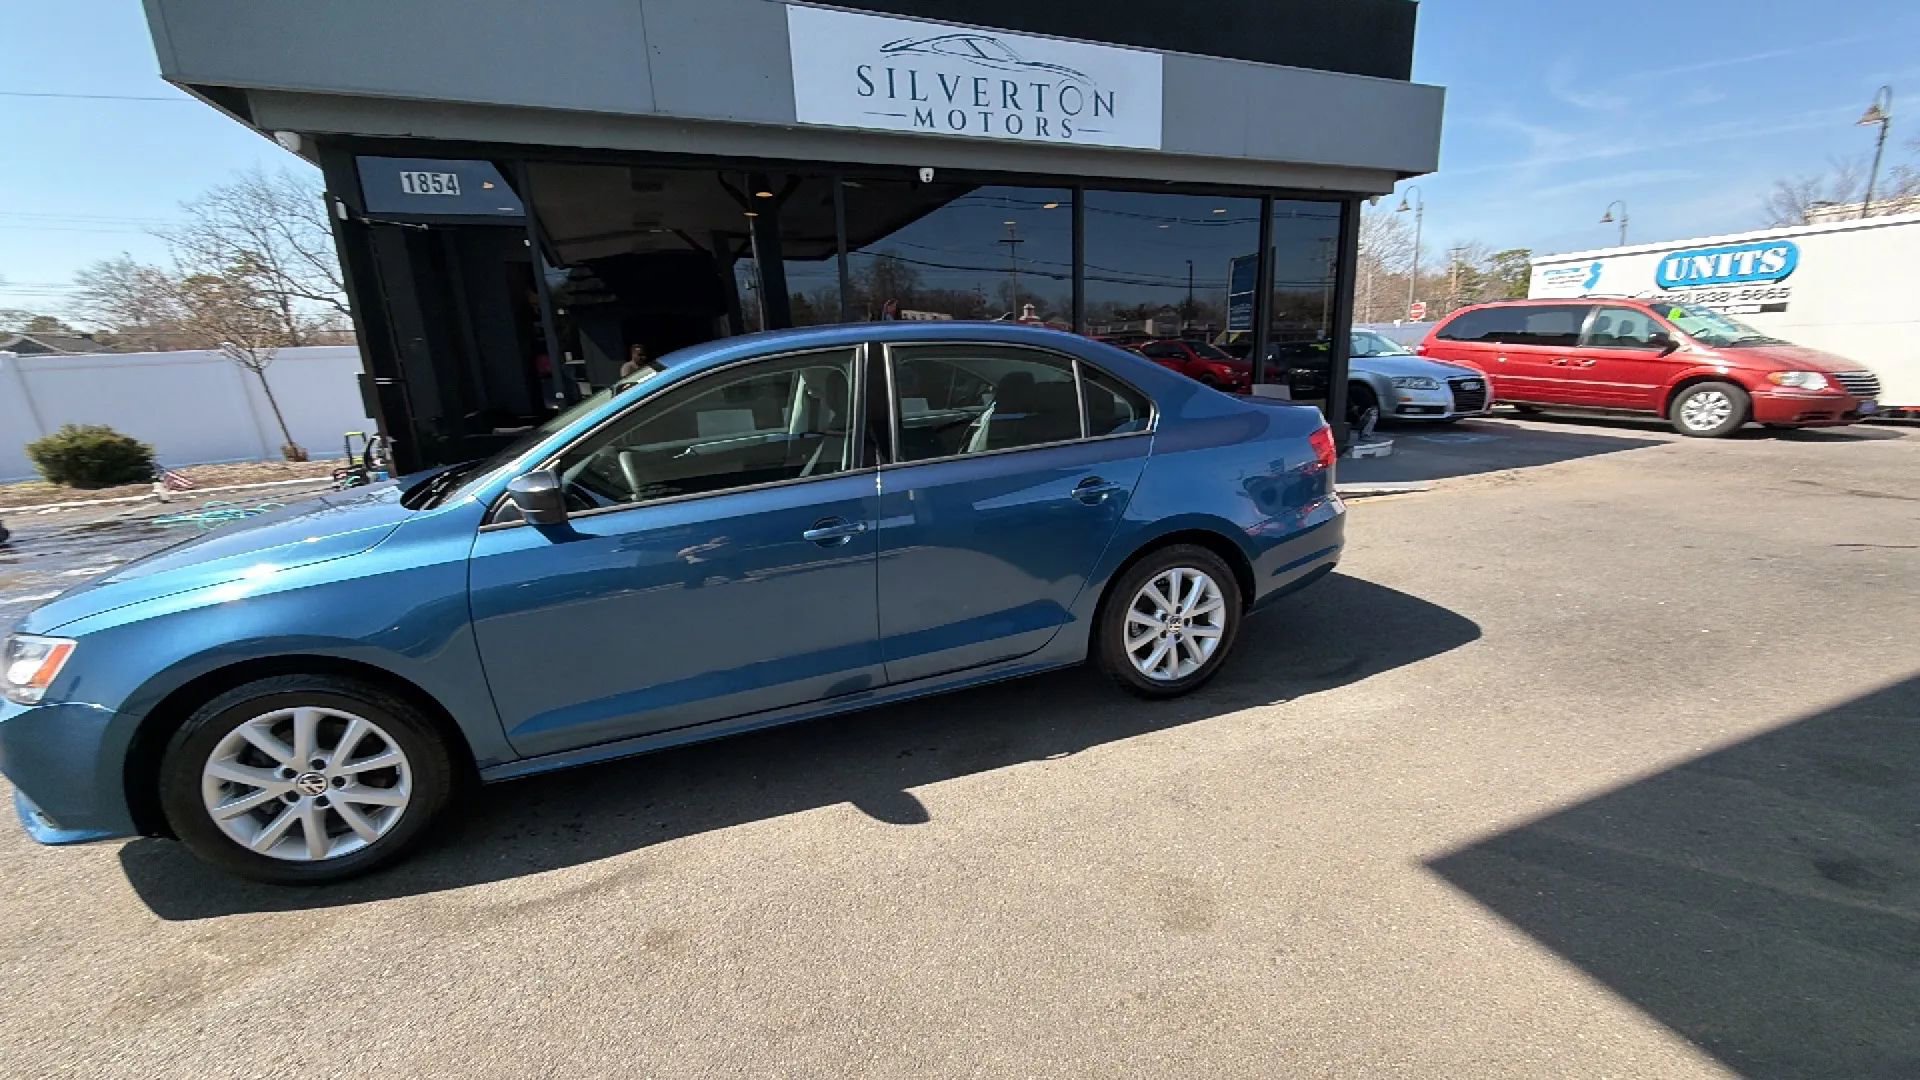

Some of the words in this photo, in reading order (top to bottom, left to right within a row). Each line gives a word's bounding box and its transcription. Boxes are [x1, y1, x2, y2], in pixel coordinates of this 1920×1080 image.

[856, 64, 1115, 118] SILVERTON
[913, 106, 1073, 139] MOTORS
[403, 172, 458, 195] 1854
[1664, 247, 1789, 281] UNITS
